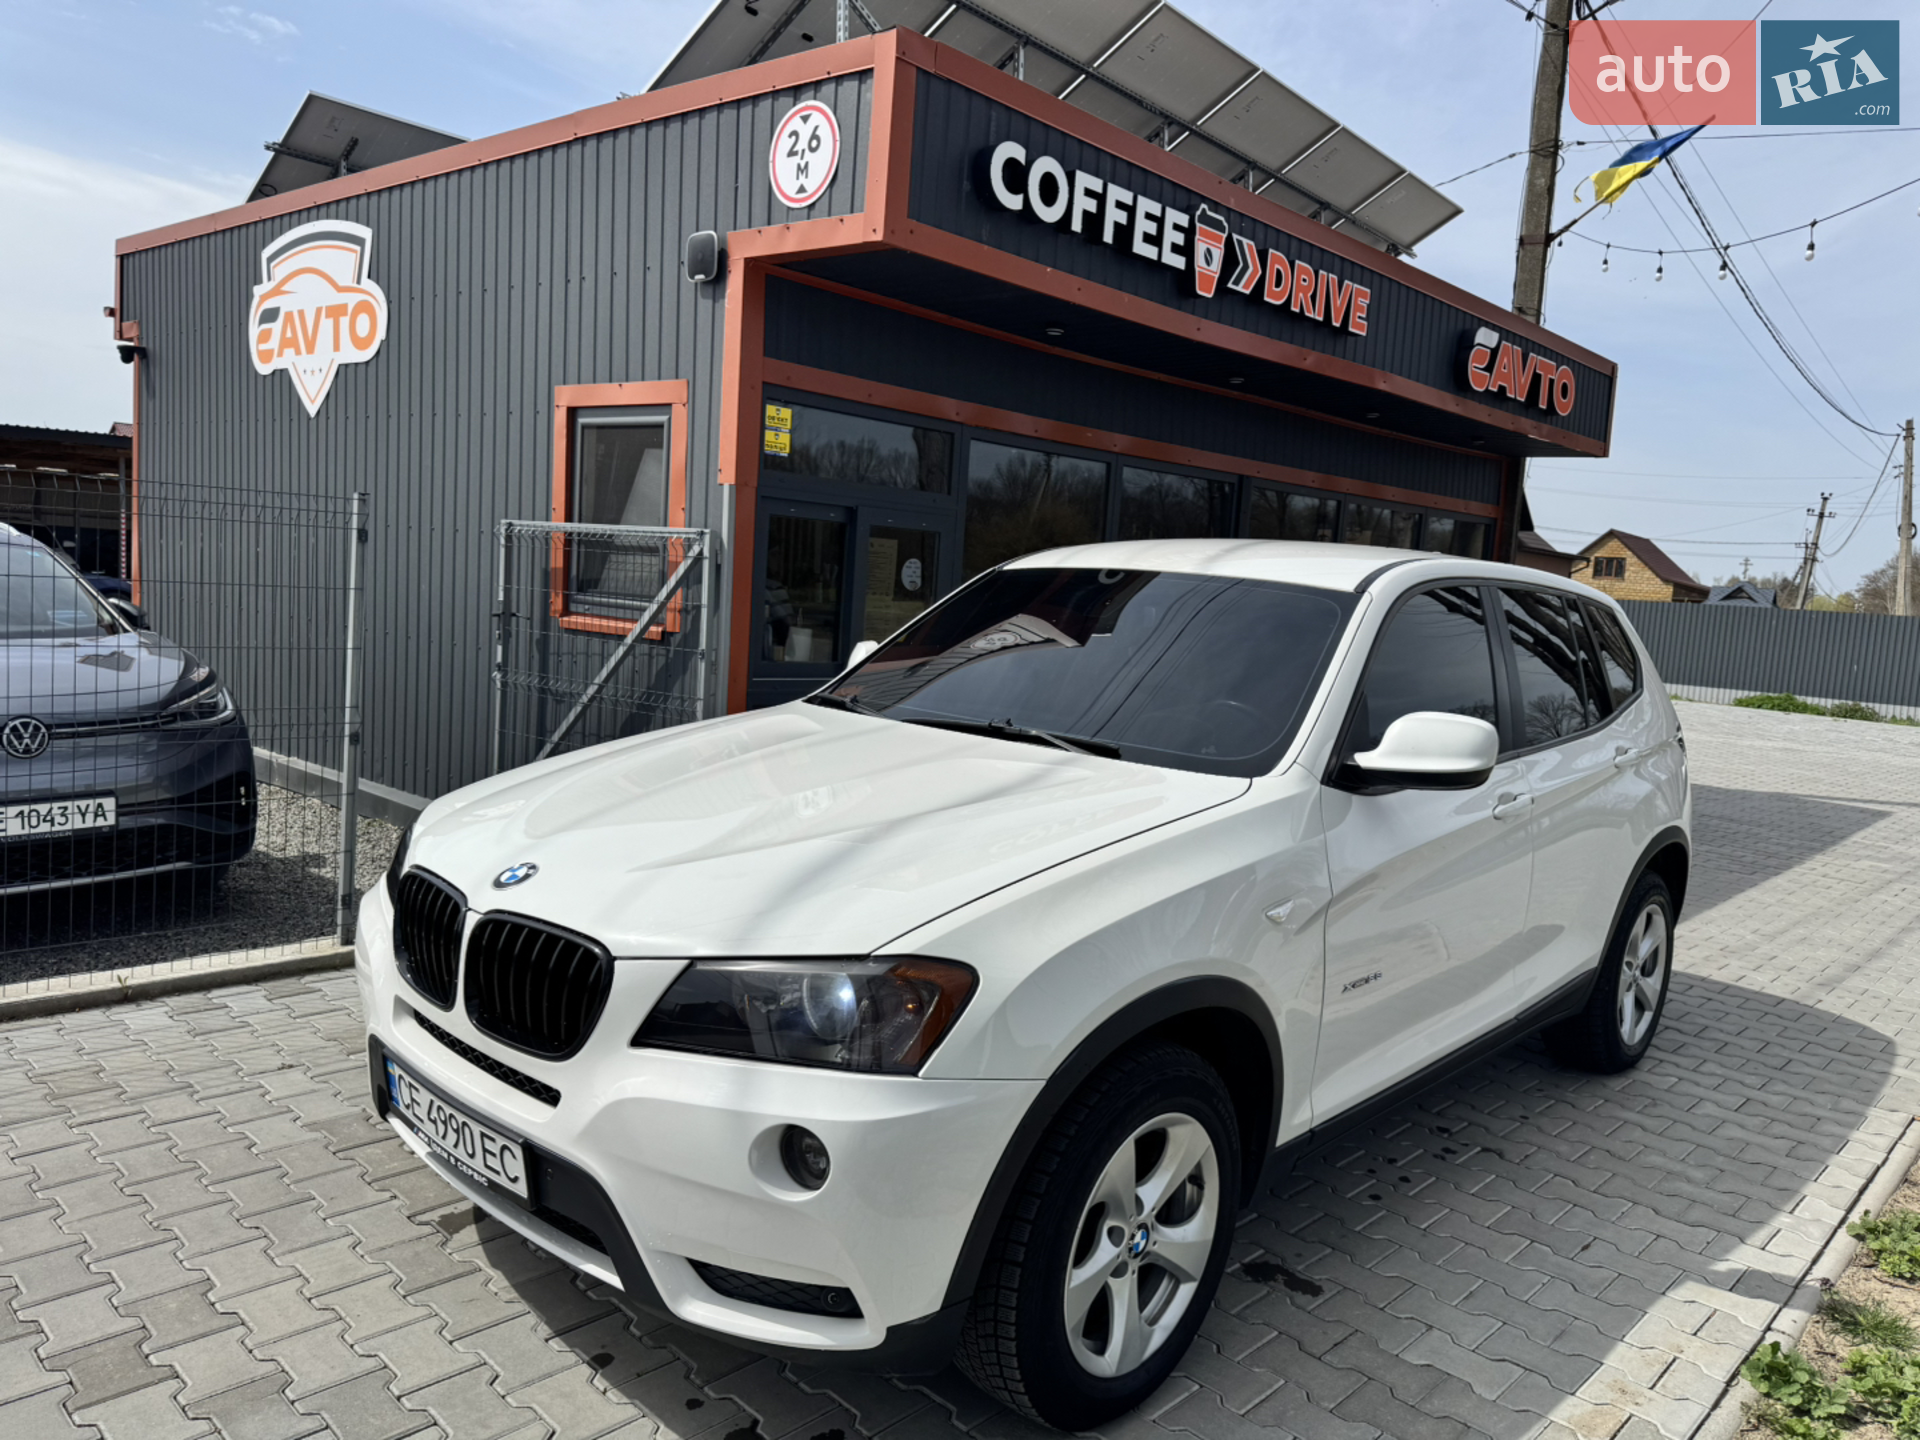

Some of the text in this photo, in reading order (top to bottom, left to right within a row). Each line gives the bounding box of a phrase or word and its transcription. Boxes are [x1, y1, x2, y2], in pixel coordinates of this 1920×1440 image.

[786, 124, 822, 160] 2,6
[990, 140, 1371, 336] COFFEE DRIVE
[14, 806, 69, 830] 1043
[76, 802, 108, 824] YA
[398, 1073, 520, 1184] CE 4990 EC
